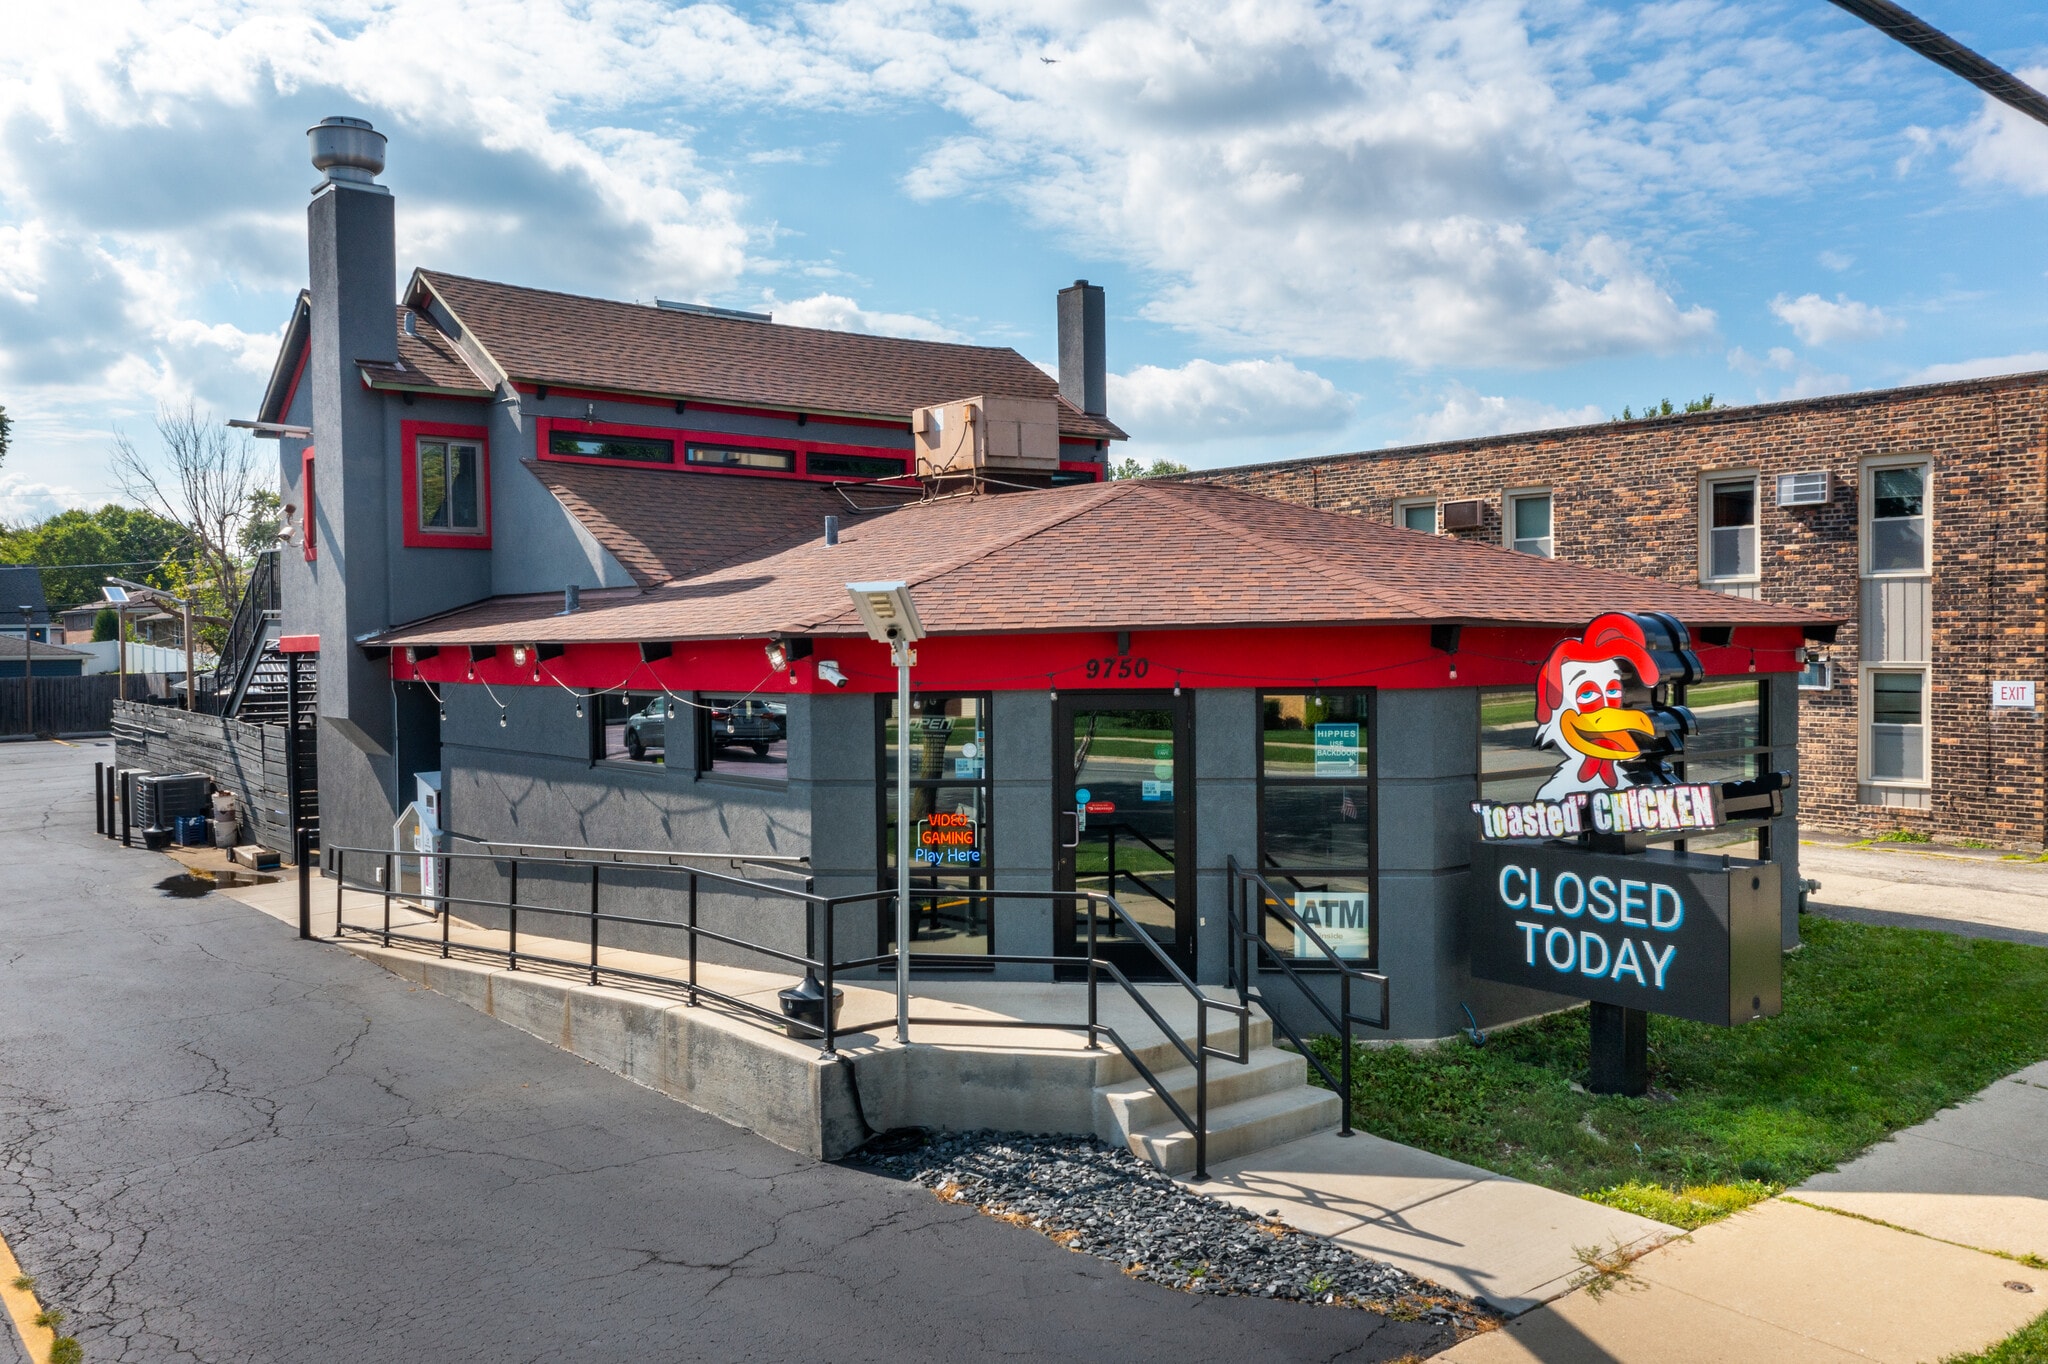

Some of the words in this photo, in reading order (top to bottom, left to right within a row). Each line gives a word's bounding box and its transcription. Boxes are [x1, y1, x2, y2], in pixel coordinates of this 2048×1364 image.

[1086, 658, 1149, 679] 9750
[2001, 686, 2027, 700] EXIT
[1318, 730, 1356, 738] HIPPIES
[1329, 740, 1344, 748] USE
[1593, 786, 1714, 832] CHICKEN
[928, 813, 968, 827] VIDEO
[922, 831, 973, 845] GAMING
[915, 848, 944, 866] Play
[948, 848, 980, 862] Here
[1499, 865, 1684, 932] CLOSED
[1302, 900, 1364, 928] ATM
[1515, 920, 1677, 991] TODAY
